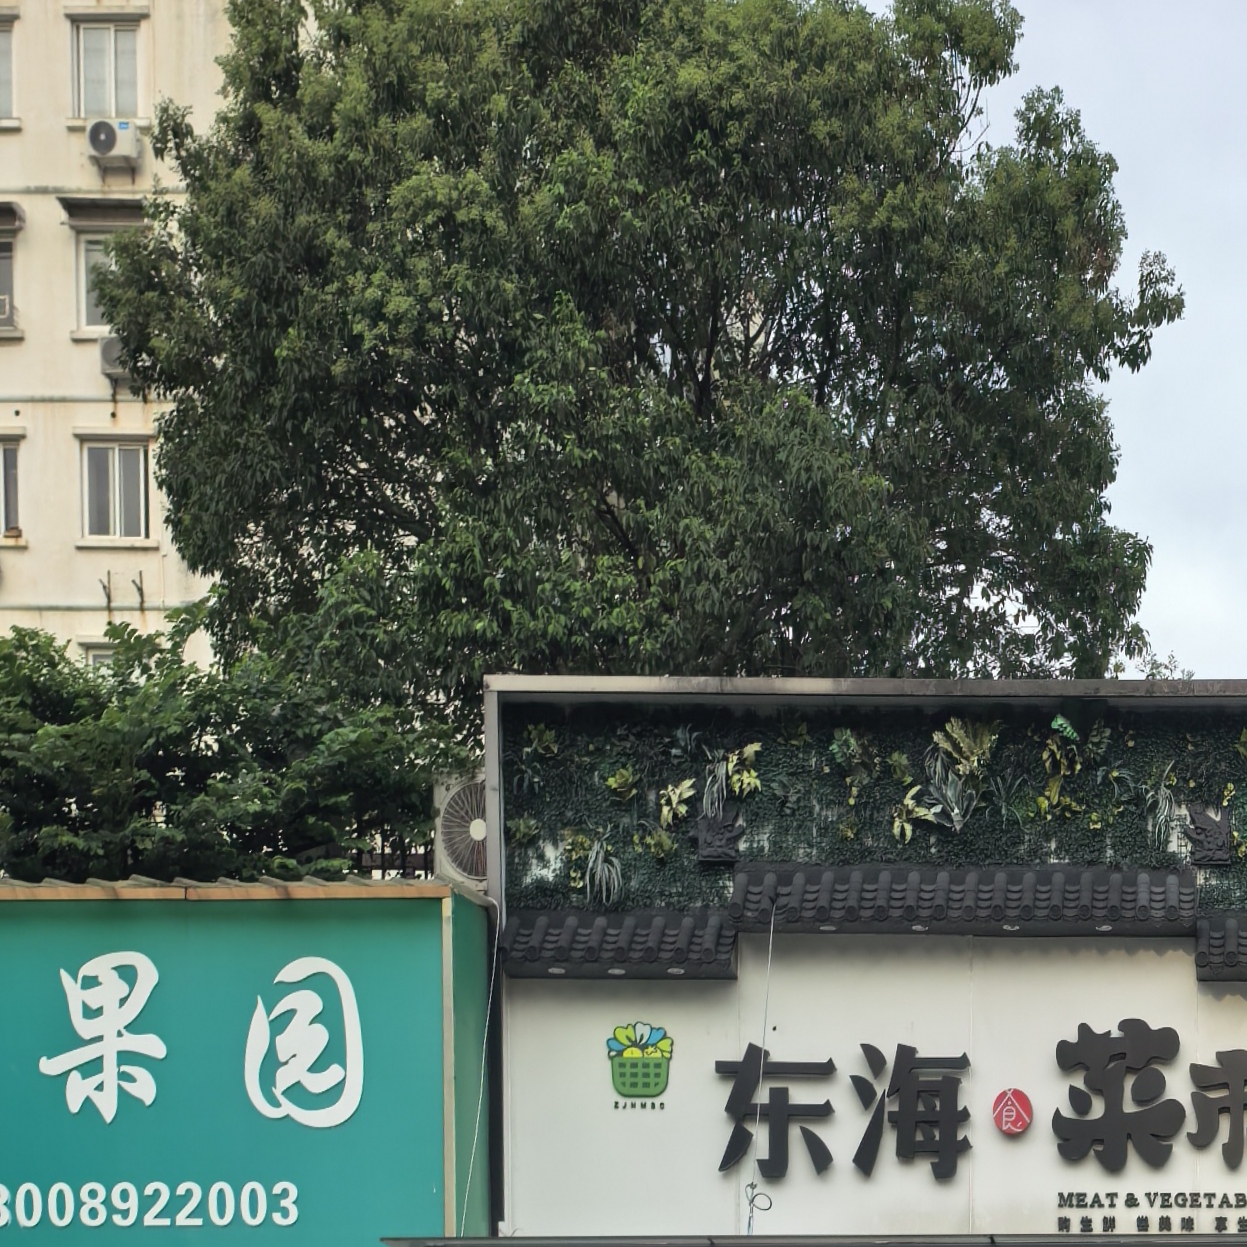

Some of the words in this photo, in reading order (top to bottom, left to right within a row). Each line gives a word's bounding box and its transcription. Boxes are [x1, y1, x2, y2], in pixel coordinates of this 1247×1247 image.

[39, 951, 364, 1127] 果园
[714, 1042, 973, 1180] 东海
[1057, 1192, 1118, 1208] MEAT
[1124, 1193, 1140, 1208] &
